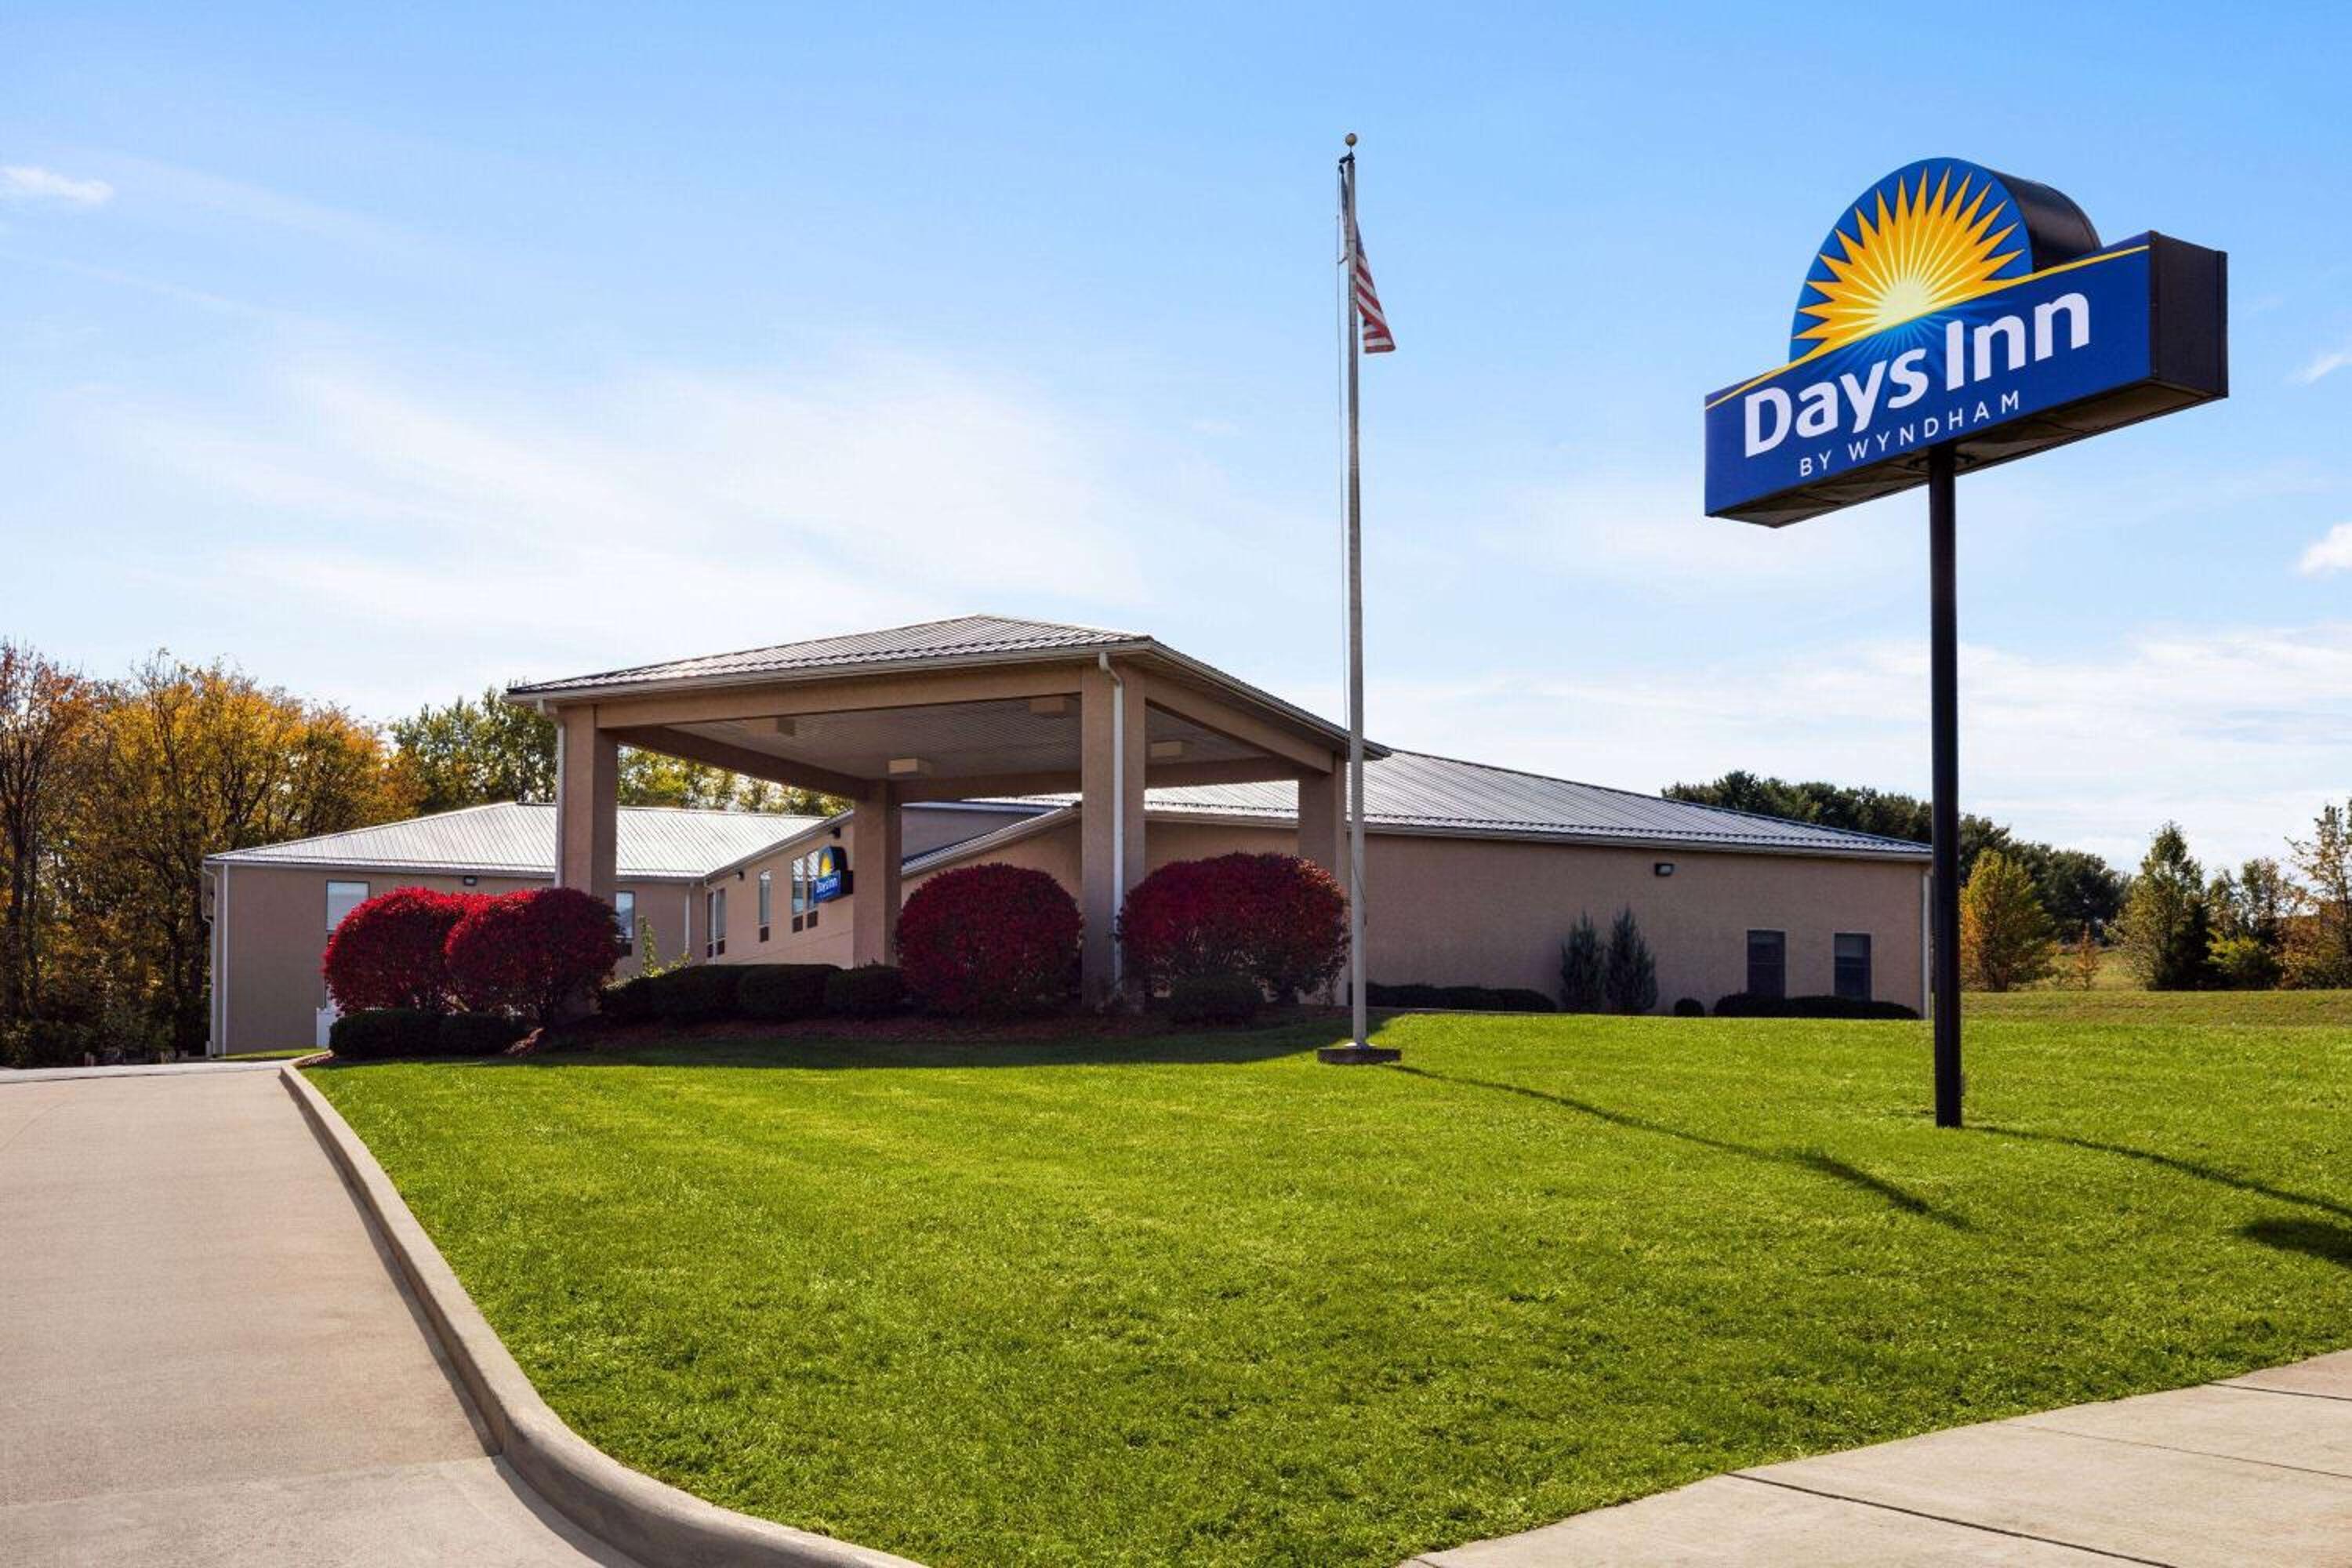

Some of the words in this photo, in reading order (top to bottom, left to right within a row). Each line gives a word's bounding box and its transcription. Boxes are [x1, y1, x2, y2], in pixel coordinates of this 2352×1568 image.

[1745, 348, 1929, 457] Days
[1947, 292, 2089, 390] Inn
[1799, 450, 1831, 477] BY
[1848, 390, 2019, 462] WYNDHAM
